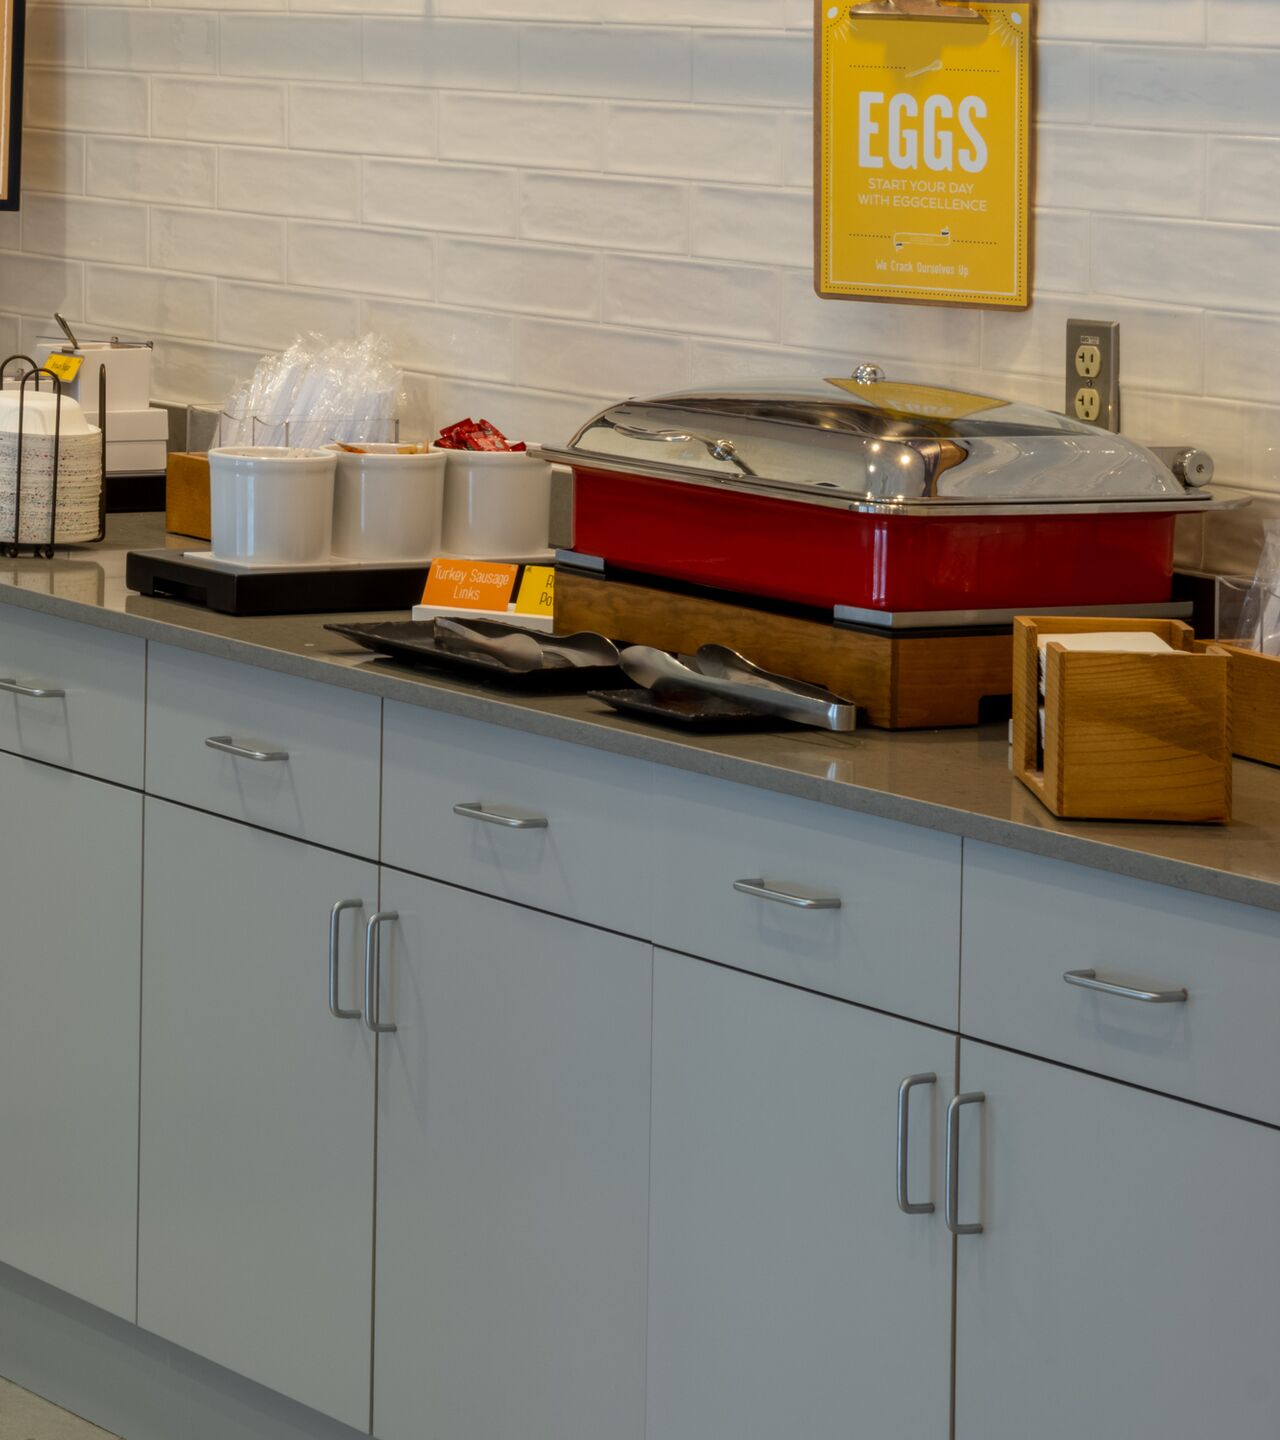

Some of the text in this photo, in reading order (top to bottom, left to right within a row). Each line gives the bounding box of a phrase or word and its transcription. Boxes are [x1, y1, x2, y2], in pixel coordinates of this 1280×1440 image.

[858, 90, 988, 174] EGGS
[868, 177, 974, 194] START YOUR DAY
[858, 193, 987, 212] WITH EGGCELLENCE
[435, 565, 510, 588] Turkey Sausage
[453, 586, 480, 600] Links
